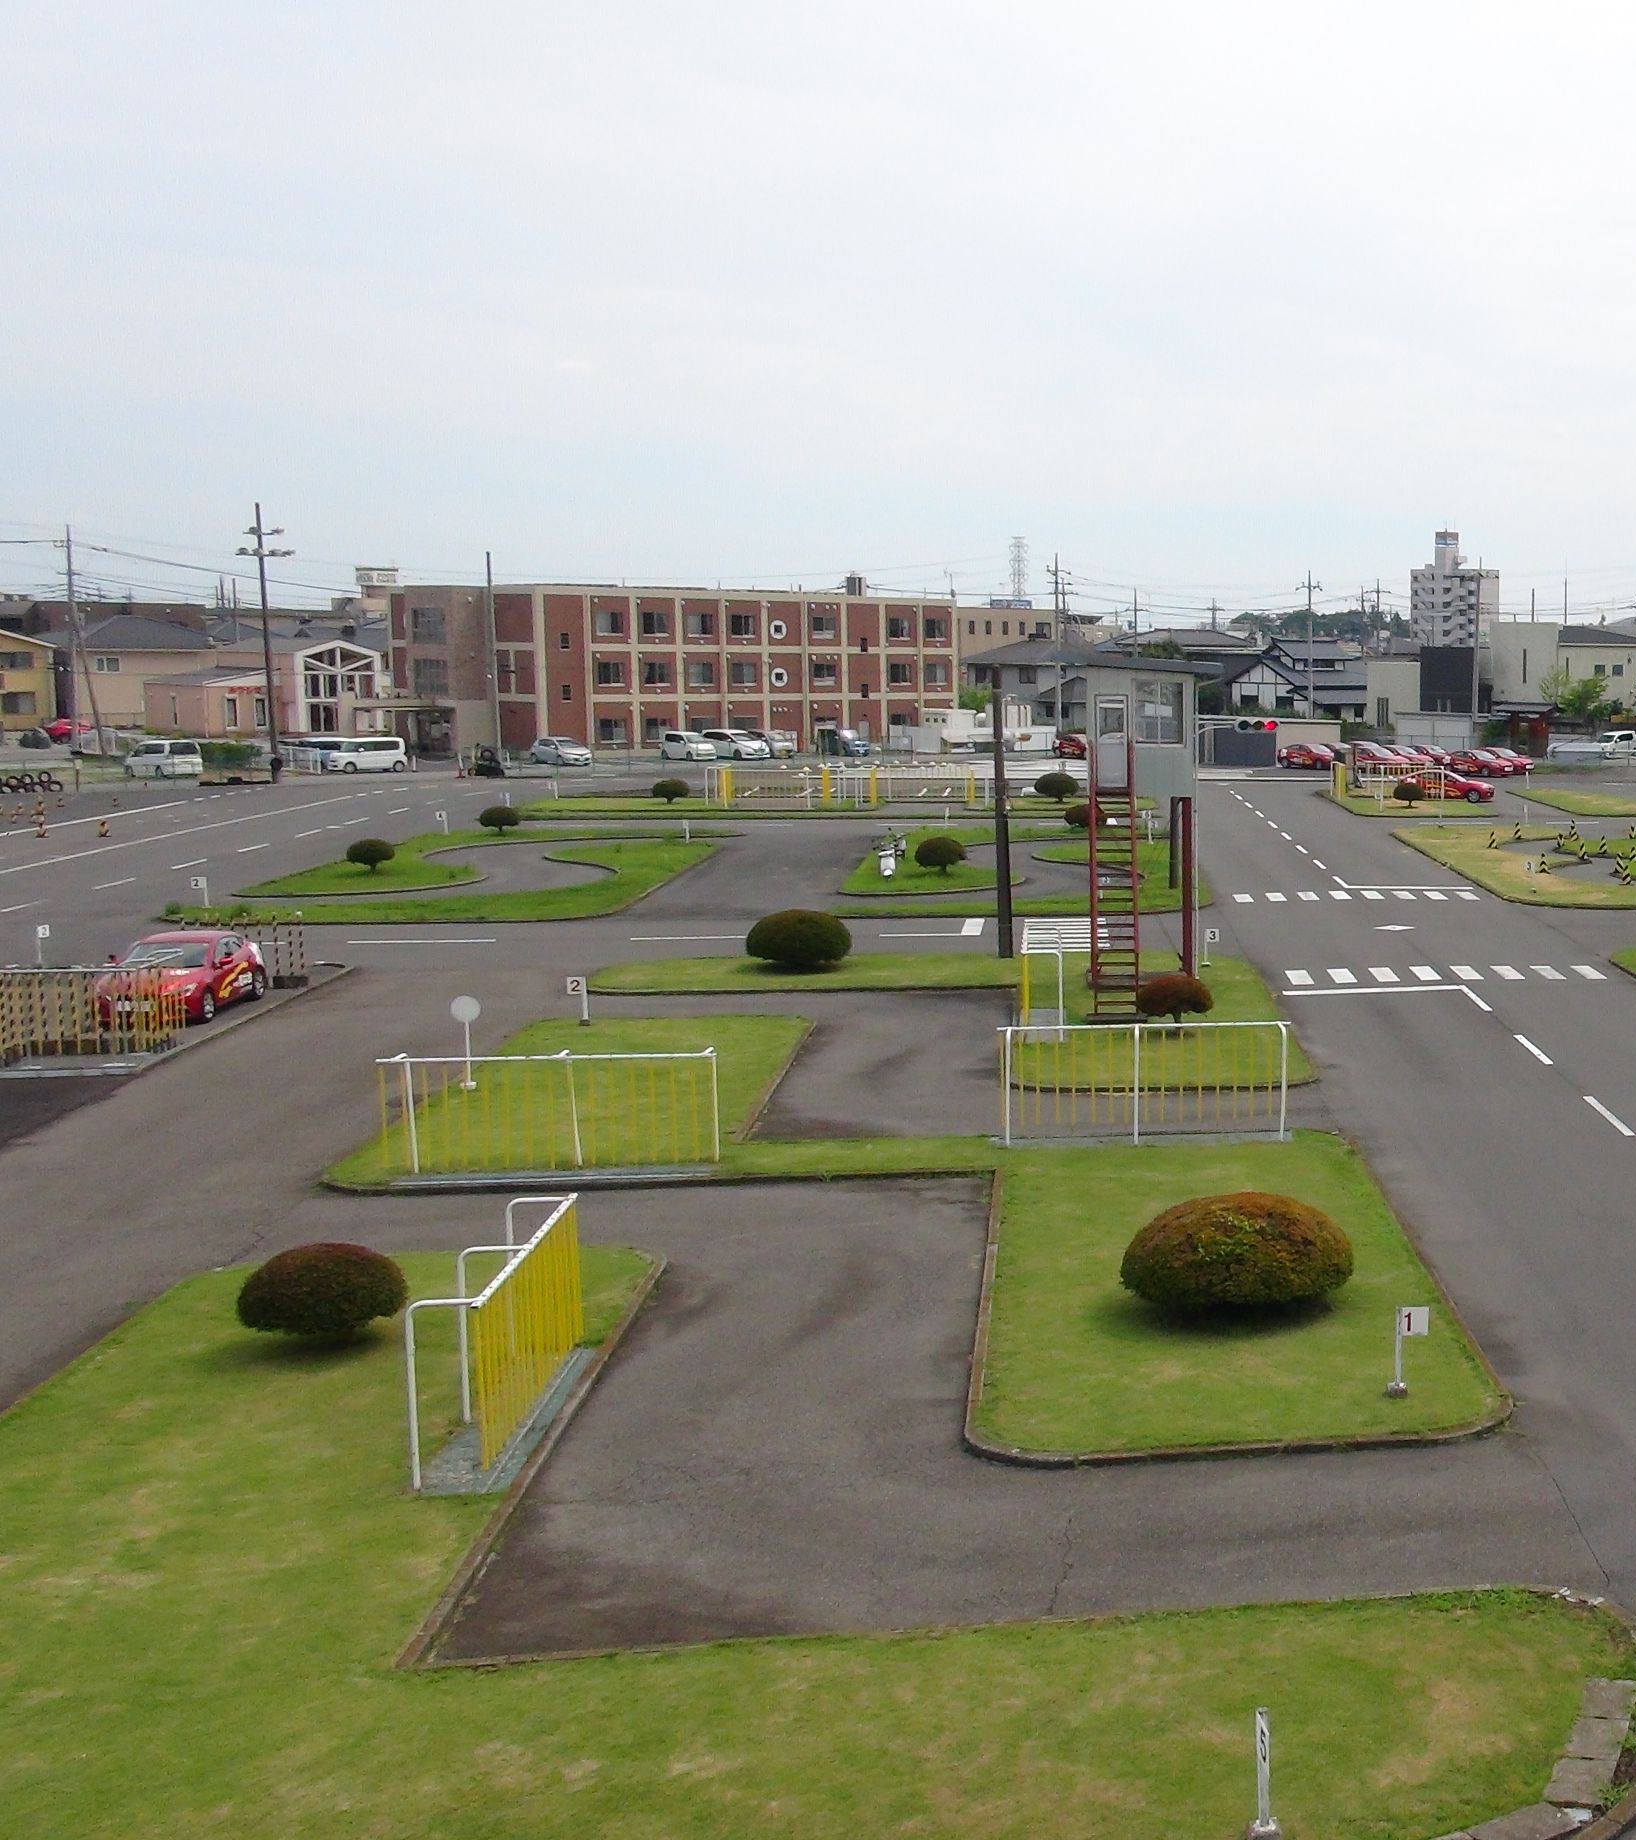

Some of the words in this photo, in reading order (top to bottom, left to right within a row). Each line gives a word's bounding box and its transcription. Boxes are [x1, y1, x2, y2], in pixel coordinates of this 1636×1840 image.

[1209, 930, 1216, 940] 3
[569, 979, 581, 992] 2
[1404, 1312, 1412, 1332] 1
[1260, 1727, 1268, 1763] 5
